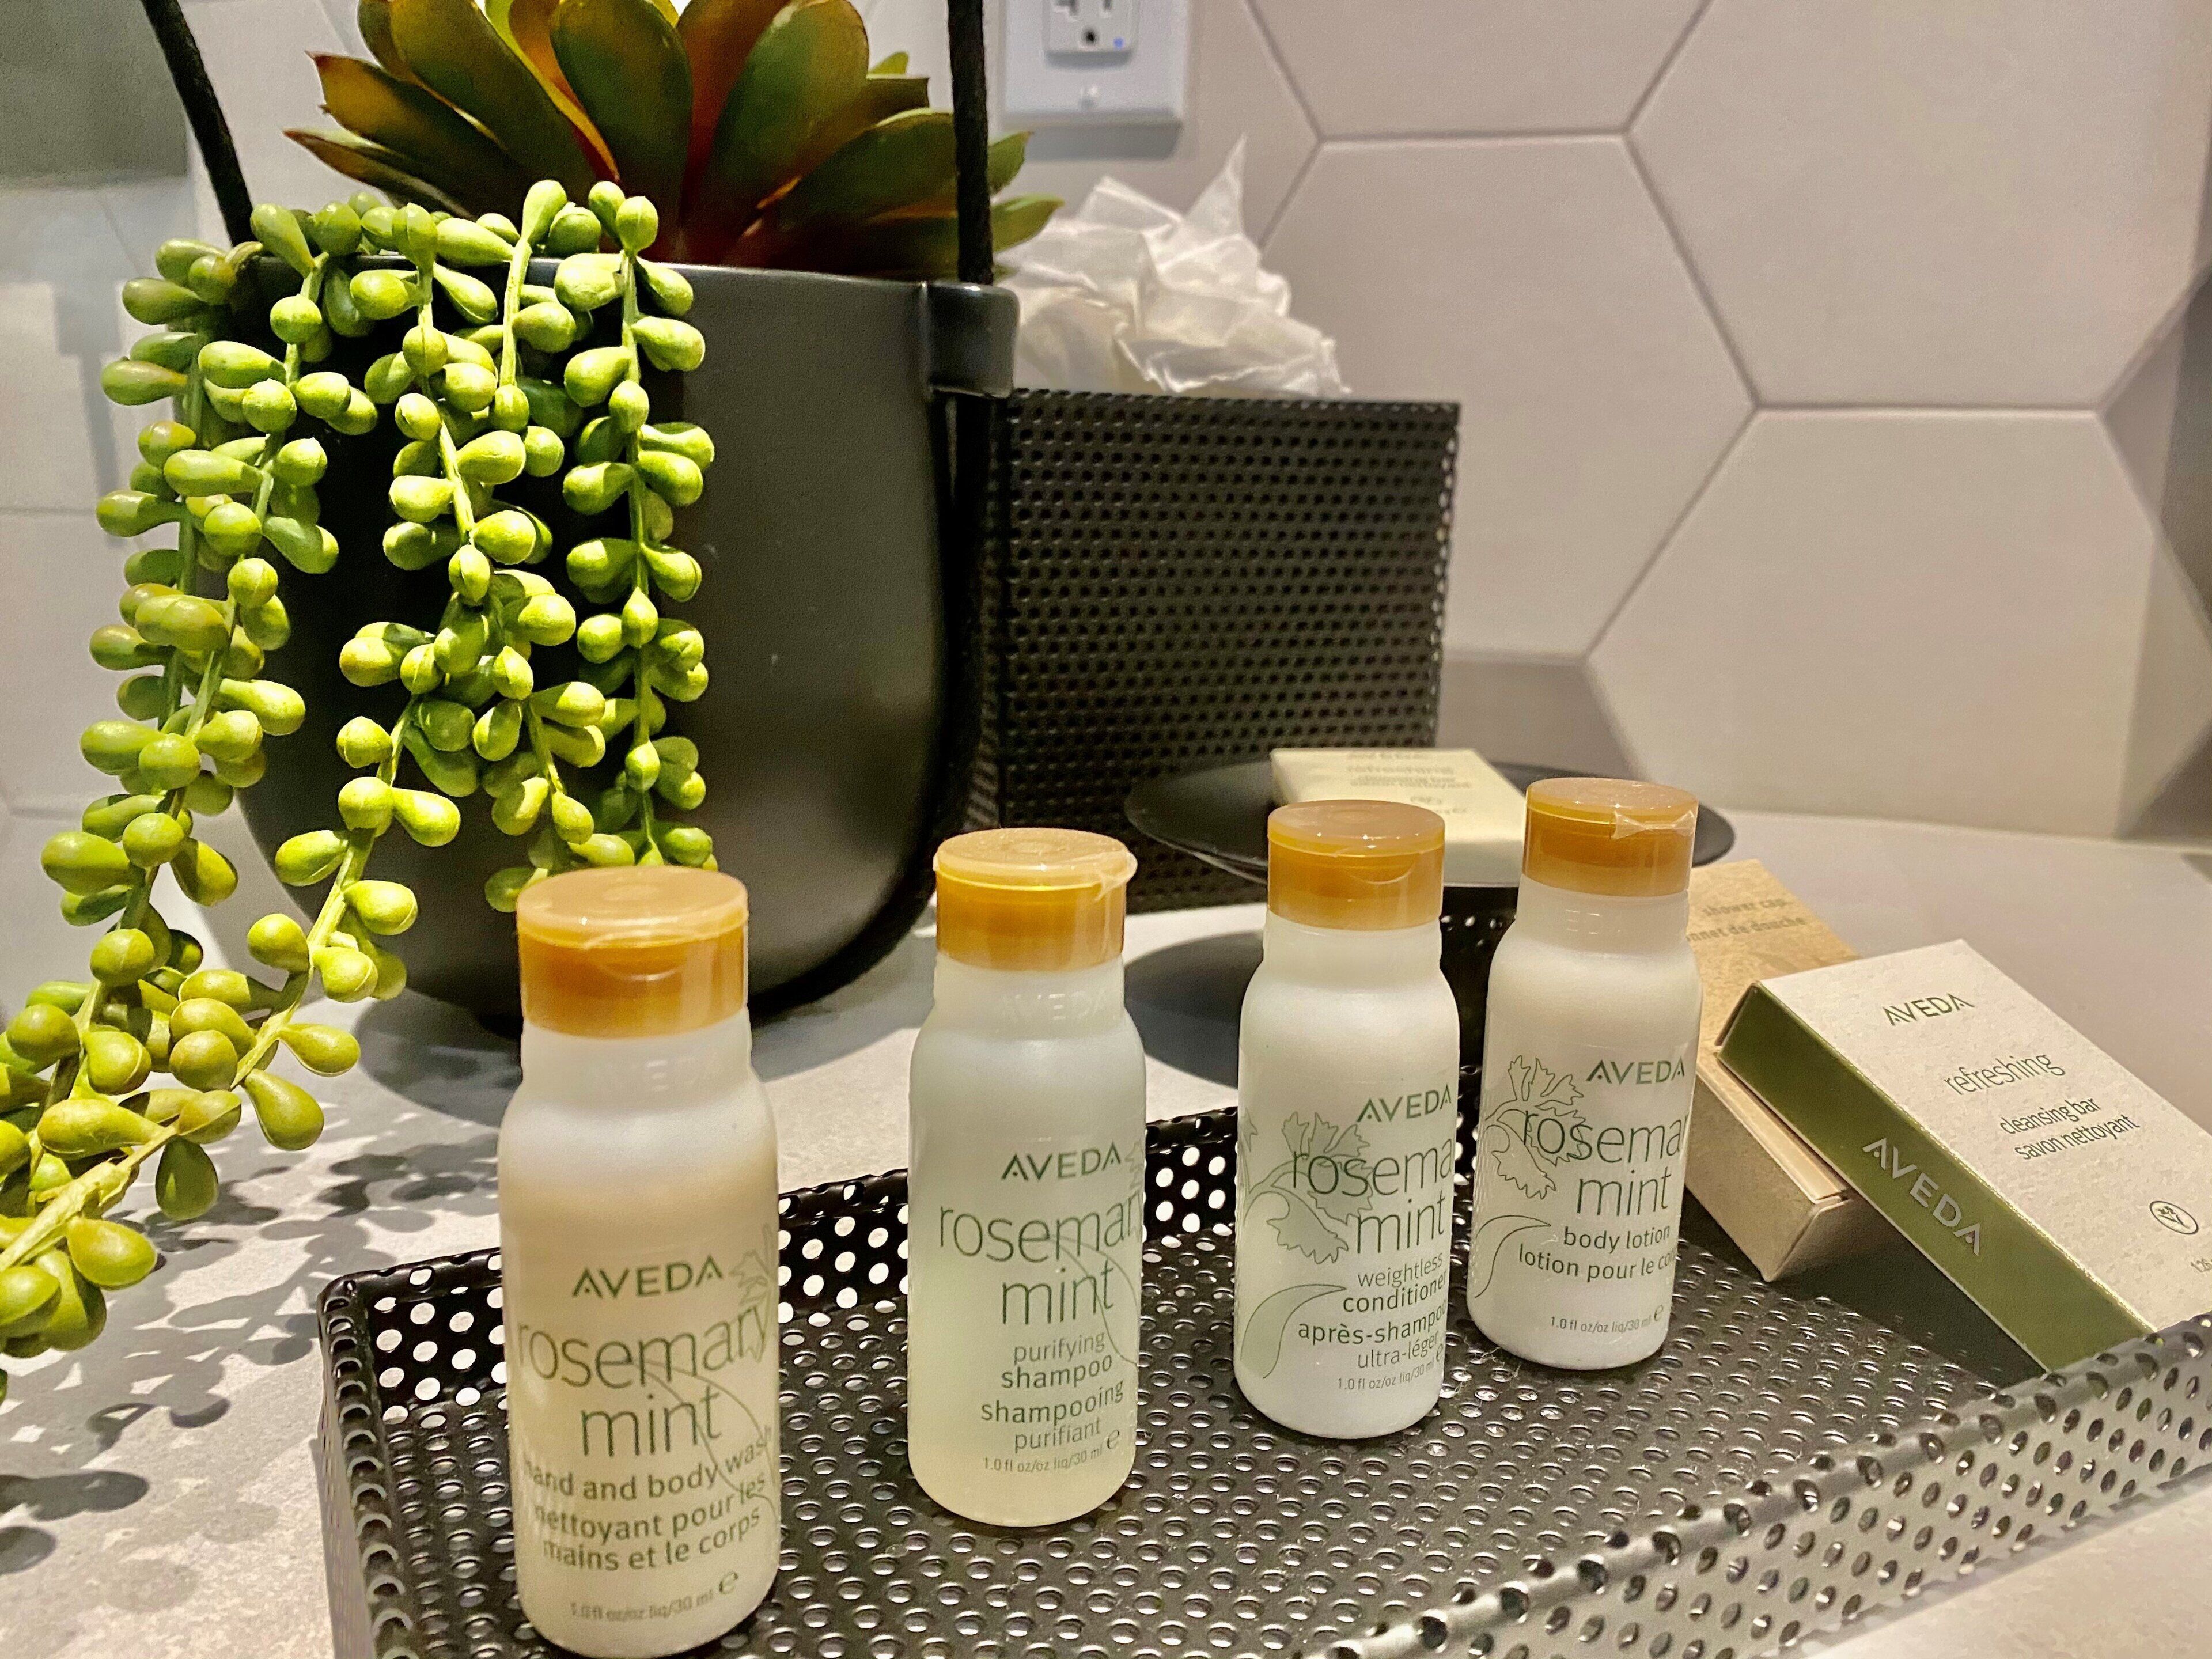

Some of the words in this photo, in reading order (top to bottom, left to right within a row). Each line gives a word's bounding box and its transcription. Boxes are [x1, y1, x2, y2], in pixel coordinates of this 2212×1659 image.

[1881, 993, 1975, 1026] AVEDA
[1586, 1056, 1685, 1084] AVEDA
[1943, 1054, 2065, 1095] refreshing
[1357, 1083, 1452, 1123] AVEDA
[1999, 1107, 2080, 1135] cleansing
[2064, 1097, 2101, 1115] bar
[2014, 1137, 2067, 1160] savon
[2061, 1114, 2141, 1147] nettoyant
[1001, 1141, 1122, 1180] AVEDA
[1577, 1166, 1672, 1216] mint
[1862, 1137, 1983, 1256] AVEDA
[1357, 1190, 1445, 1254] mint
[1564, 1226, 1620, 1253] body
[1626, 1226, 1670, 1249] lotion
[571, 1254, 724, 1299] AVEDA
[1357, 1252, 1442, 1288] weightless
[1519, 1243, 1578, 1277] lotion
[1588, 1265, 1637, 1282] pour
[1641, 1258, 1654, 1276] le
[1002, 1259, 1114, 1325] mint
[1343, 1270, 1447, 1312] conditioner
[1551, 1316, 1567, 1330] 1.0
[1580, 1321, 1608, 1334] oz/oz
[1014, 1331, 1106, 1365] purifying
[1358, 1331, 1439, 1368] ultra-léger
[1001, 1354, 1113, 1389] shampoo
[1338, 1378, 1354, 1391] 1.0
[1357, 1378, 1365, 1391] fl
[1369, 1376, 1396, 1389] oz/oz
[581, 1386, 722, 1457] mint
[980, 1380, 1124, 1427] shampooing
[1014, 1416, 1101, 1453] purifiant
[582, 1476, 638, 1501] and
[647, 1462, 718, 1498] body
[983, 1457, 1001, 1471] 1.0
[1017, 1460, 1049, 1474] oz/oz
[535, 1505, 662, 1545] nettoyant
[672, 1495, 734, 1538] pour
[543, 1540, 619, 1571] mains
[628, 1547, 656, 1570] et
[666, 1540, 690, 1565] le
[699, 1506, 760, 1555] corps
